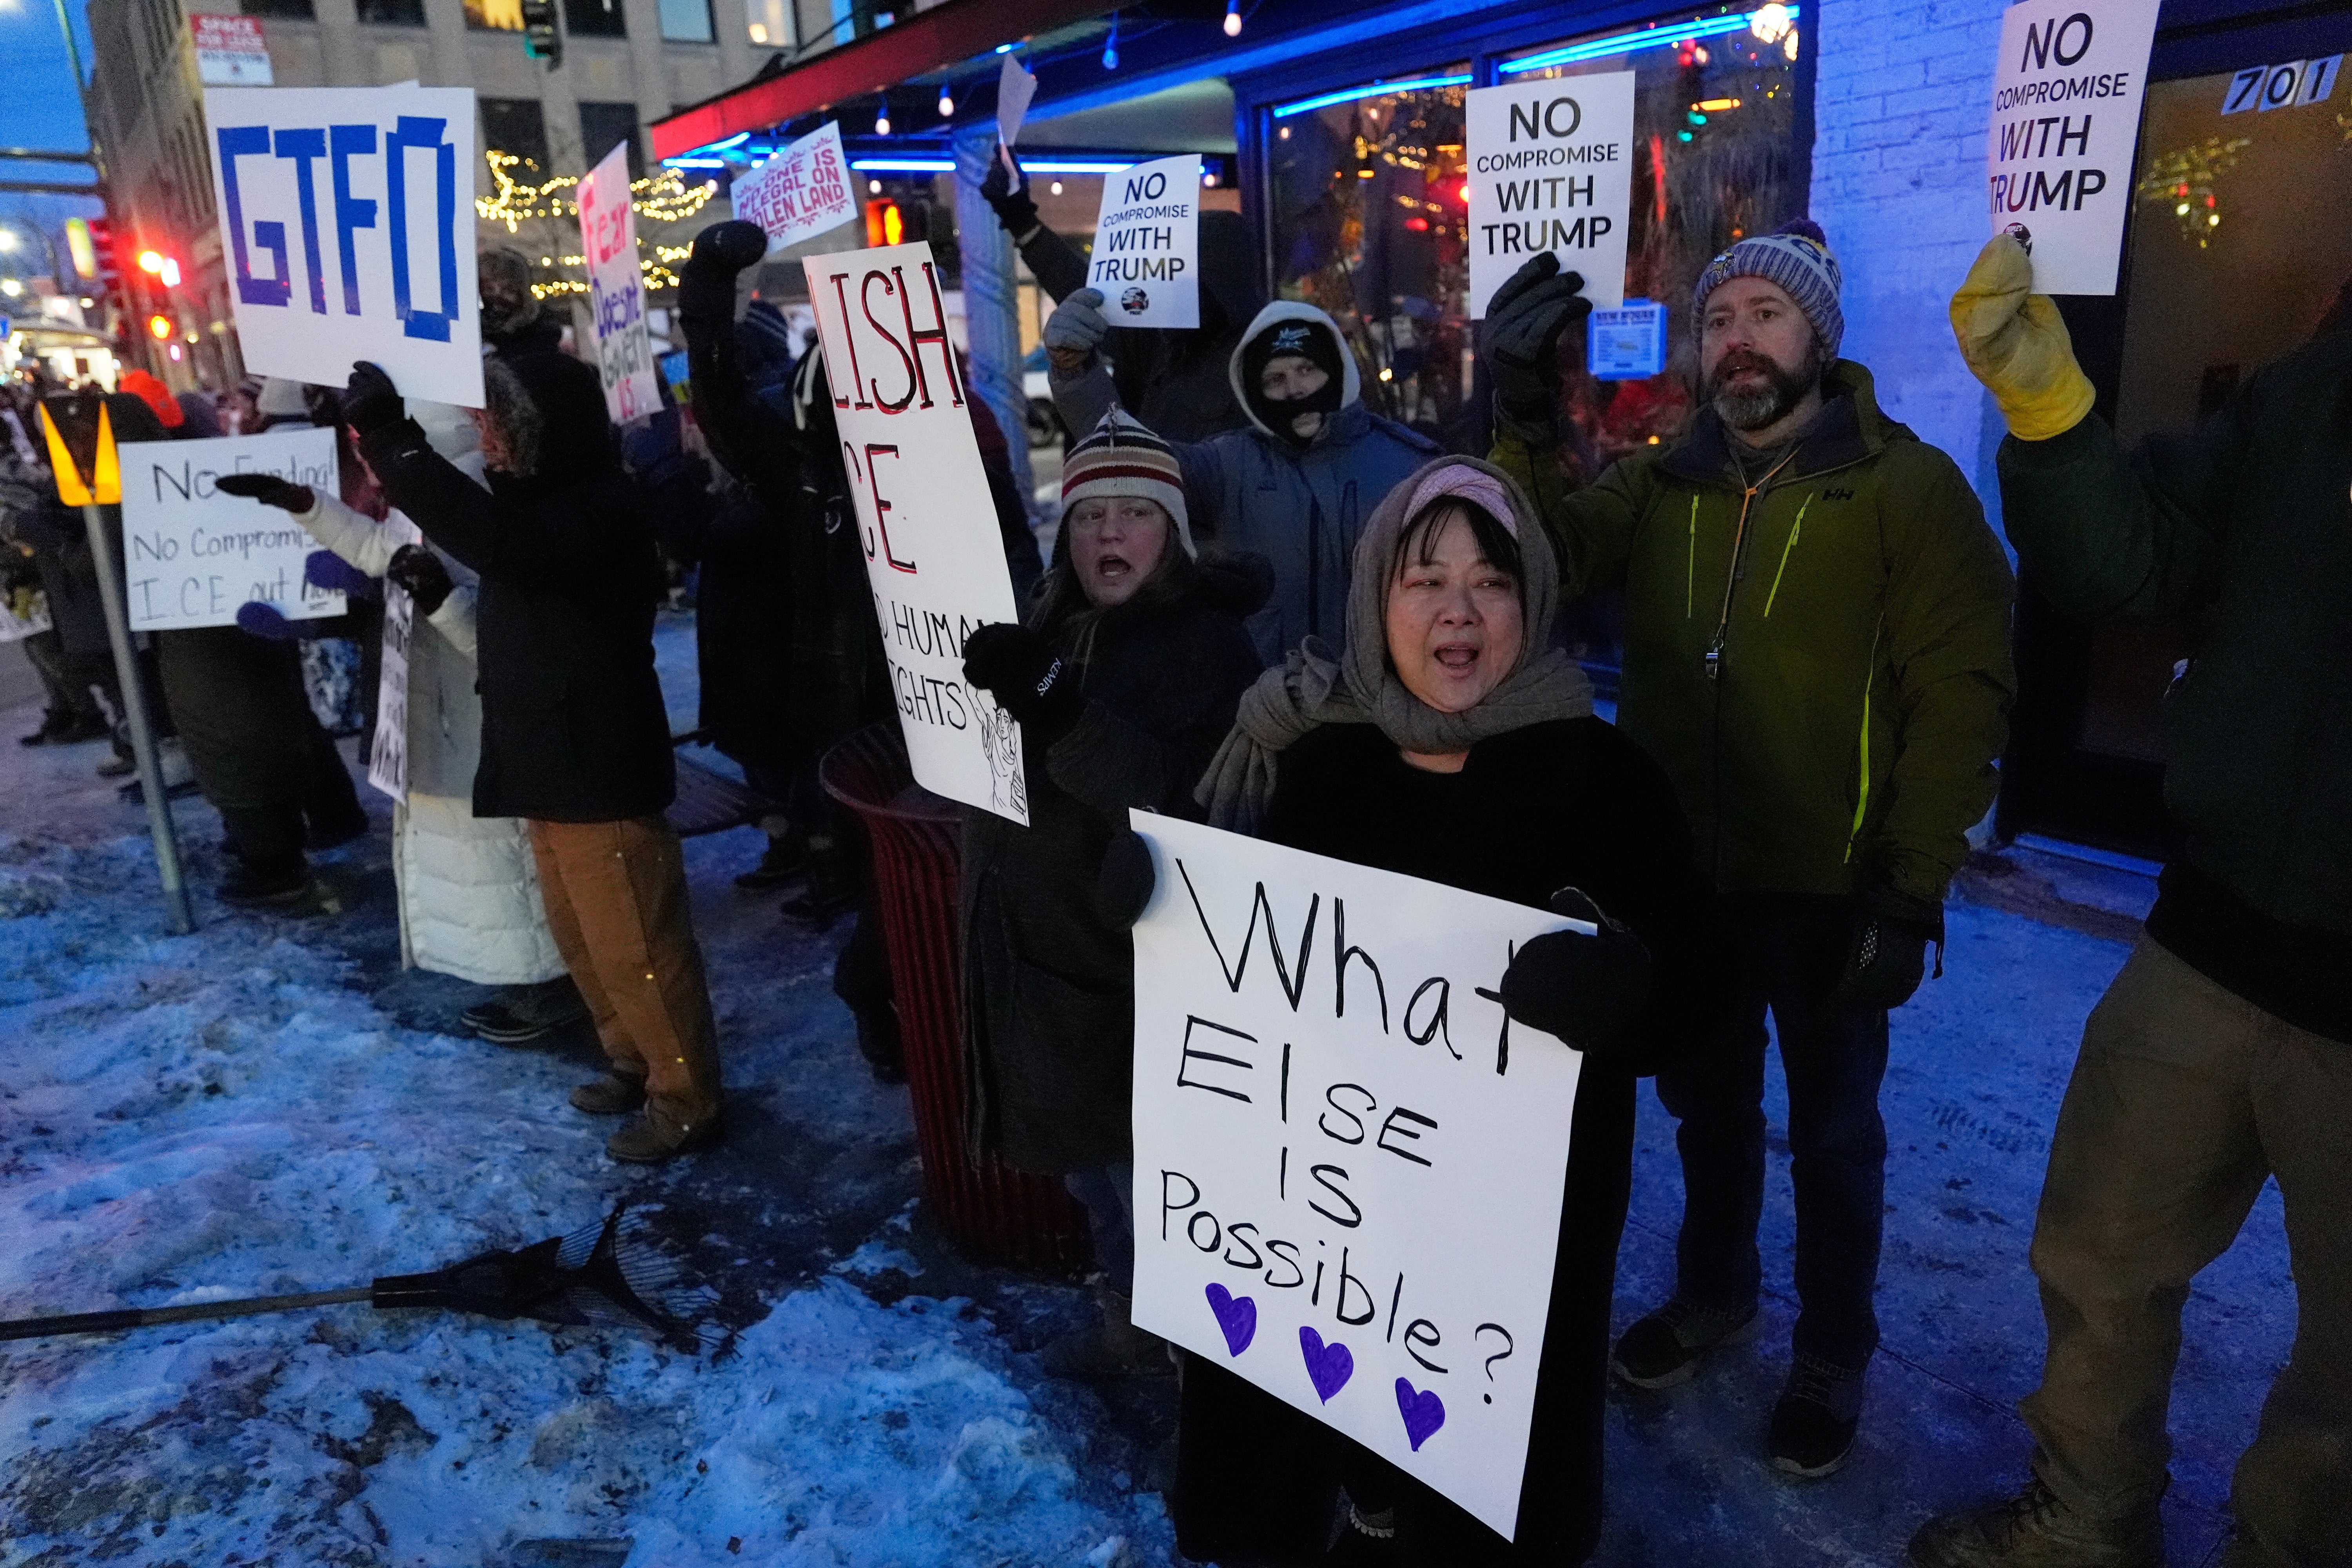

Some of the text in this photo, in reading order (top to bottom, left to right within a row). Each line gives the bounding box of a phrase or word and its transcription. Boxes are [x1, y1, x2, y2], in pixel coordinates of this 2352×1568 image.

[2021, 13, 2093, 73] NO
[1996, 73, 2129, 111] COMPROMISE
[2229, 60, 2328, 110] 701
[1510, 96, 1581, 142] NO
[2000, 114, 2092, 162] WITH
[765, 160, 804, 188] ONE
[814, 148, 836, 166] IS
[812, 167, 839, 183] ON
[1477, 143, 1619, 173] COMPROMISE
[746, 184, 845, 228] OLEN LAND
[1124, 172, 1167, 205] NO
[1496, 174, 1593, 213] WITH
[1990, 169, 2106, 214] TRUMP
[217, 116, 459, 343] GTFO
[1103, 204, 1189, 227] COMPROMISE
[1109, 226, 1172, 252] WITH
[1481, 216, 1612, 255] TRUMP
[1095, 257, 1185, 282] TRUMP
[1822, 489, 1855, 501] HH
[133, 531, 180, 561] No
[891, 601, 985, 659] HUMA
[1037, 657, 1062, 695] KEMPS
[1175, 858, 1514, 1075] What
[1280, 1146, 1362, 1228] IS
